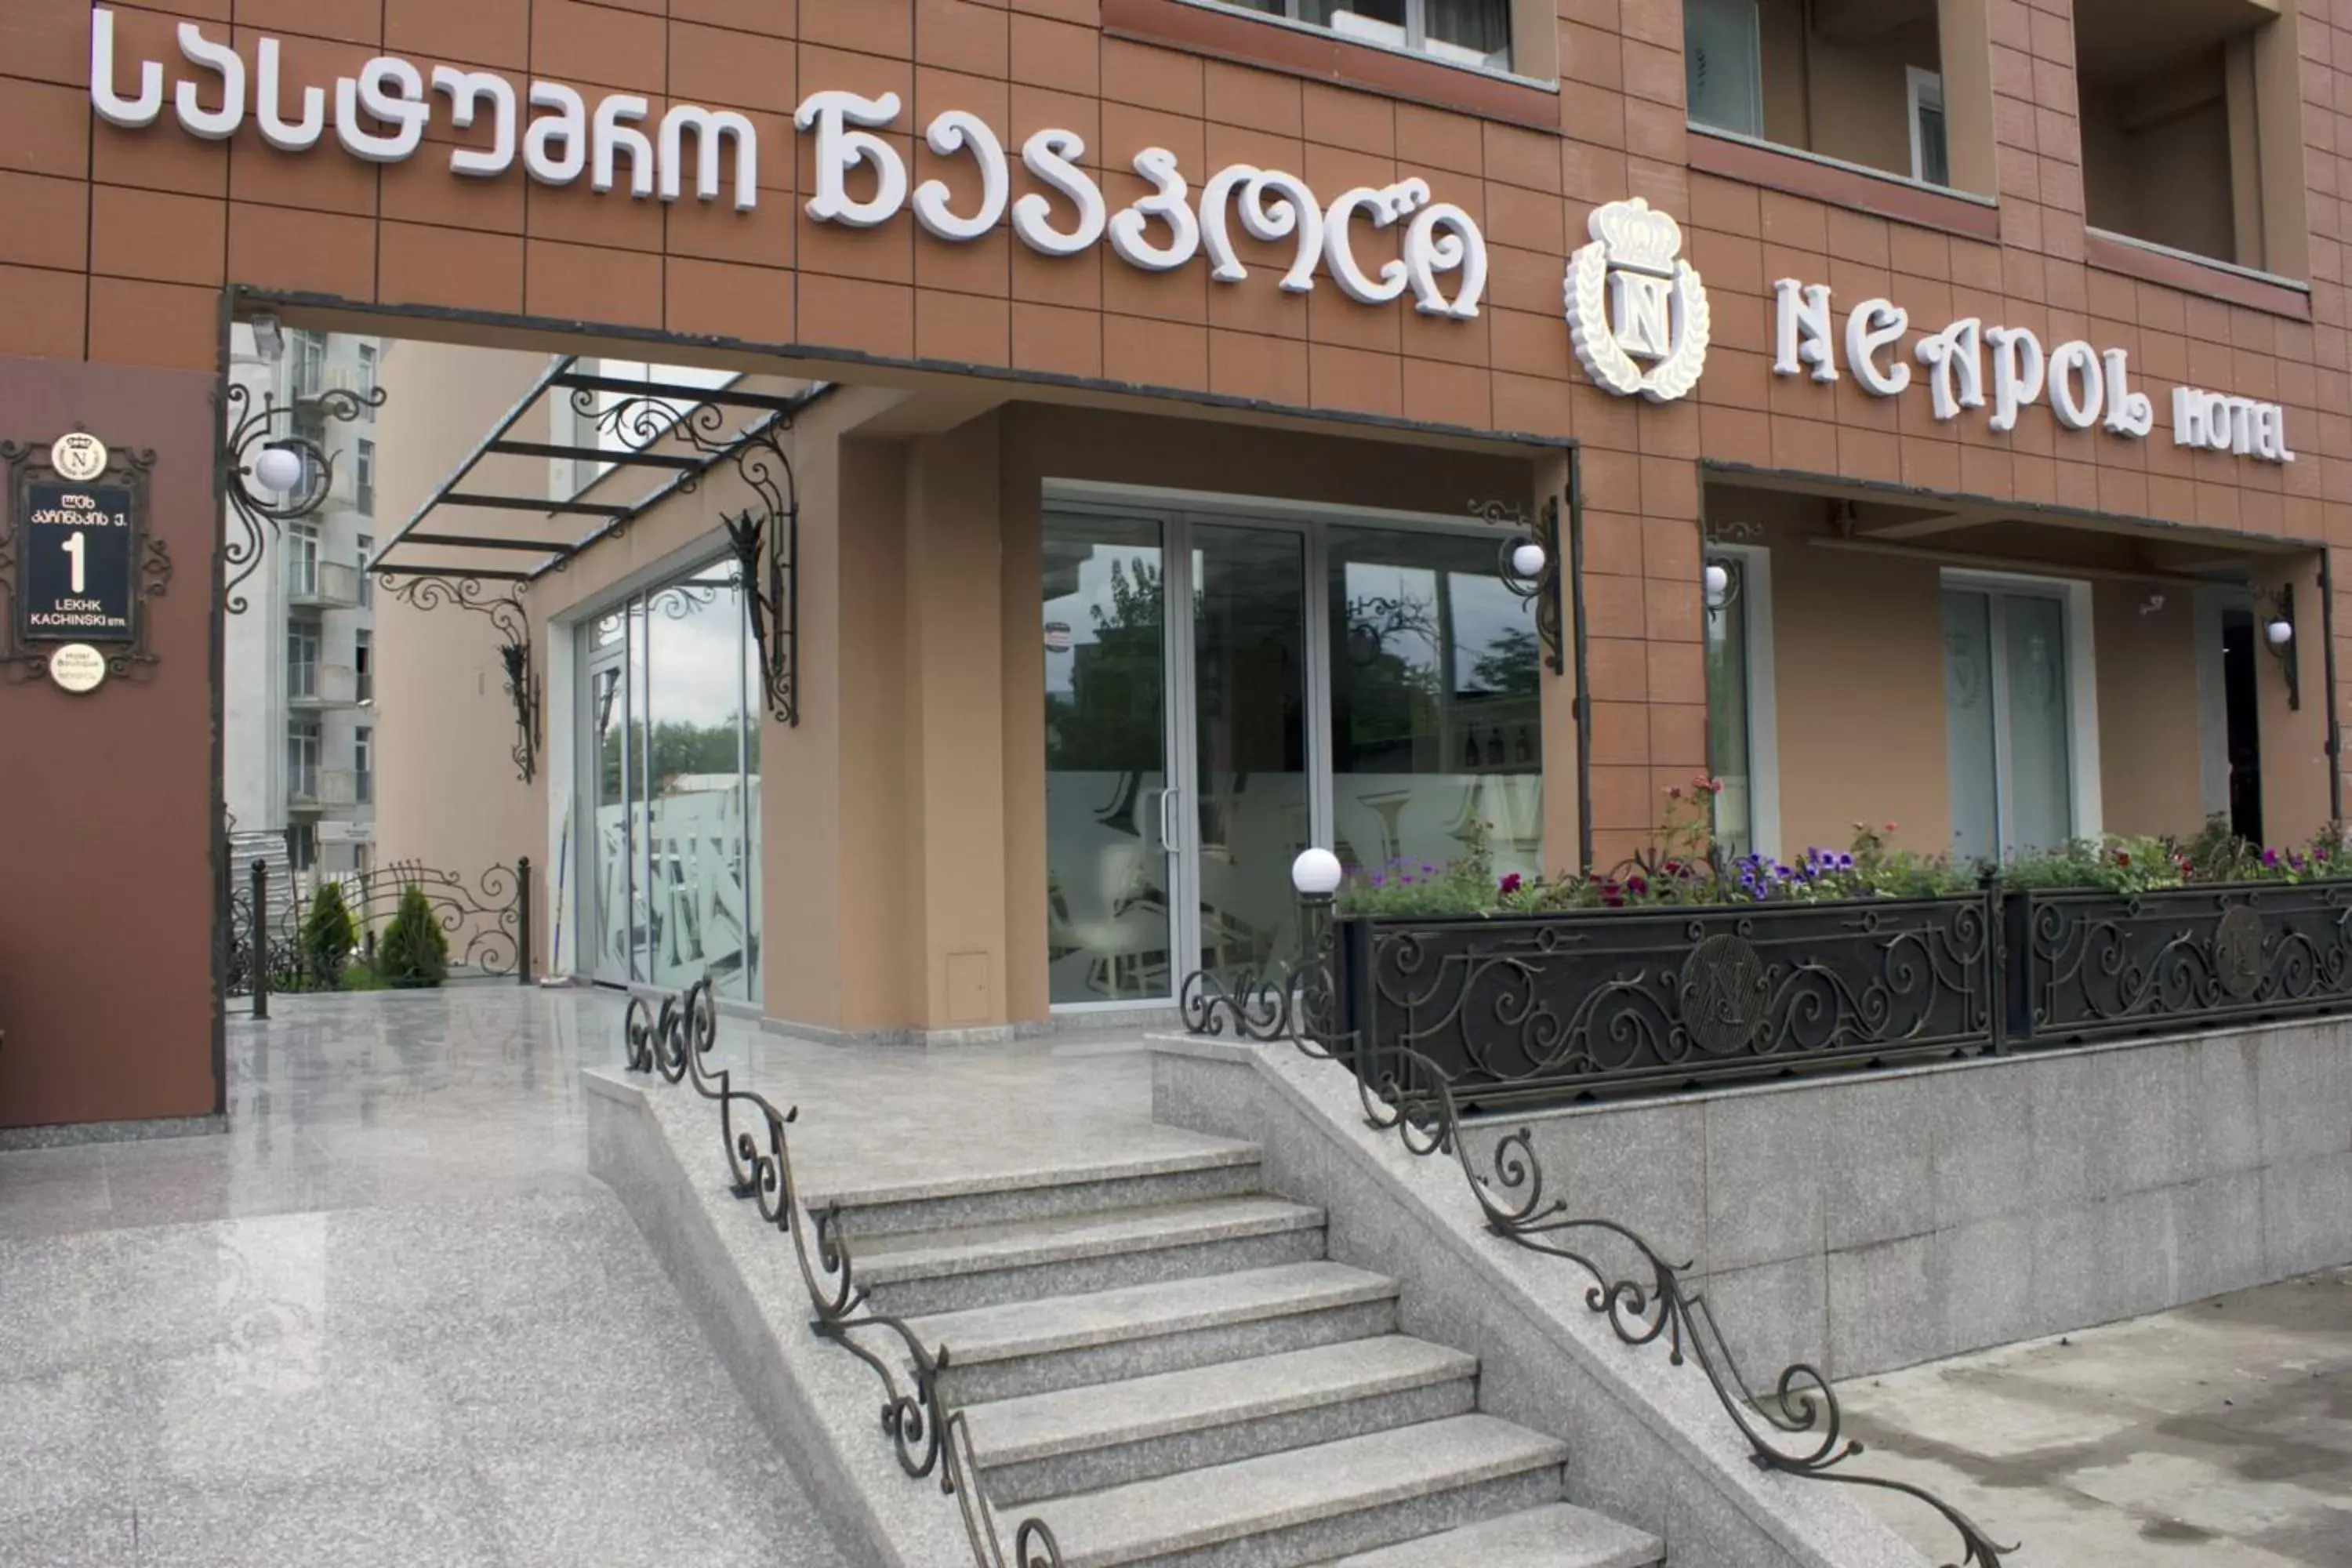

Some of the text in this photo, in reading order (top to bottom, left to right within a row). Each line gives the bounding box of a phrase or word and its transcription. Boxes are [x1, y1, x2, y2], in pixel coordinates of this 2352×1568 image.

[89, 8, 1489, 318] სასტუმრო ნეაპოლი
[1607, 270, 1673, 360] N
[1773, 278, 2296, 462] NEAPOL HOTEL
[61, 531, 85, 593] 1
[30, 612, 106, 626] KACHINSKI
